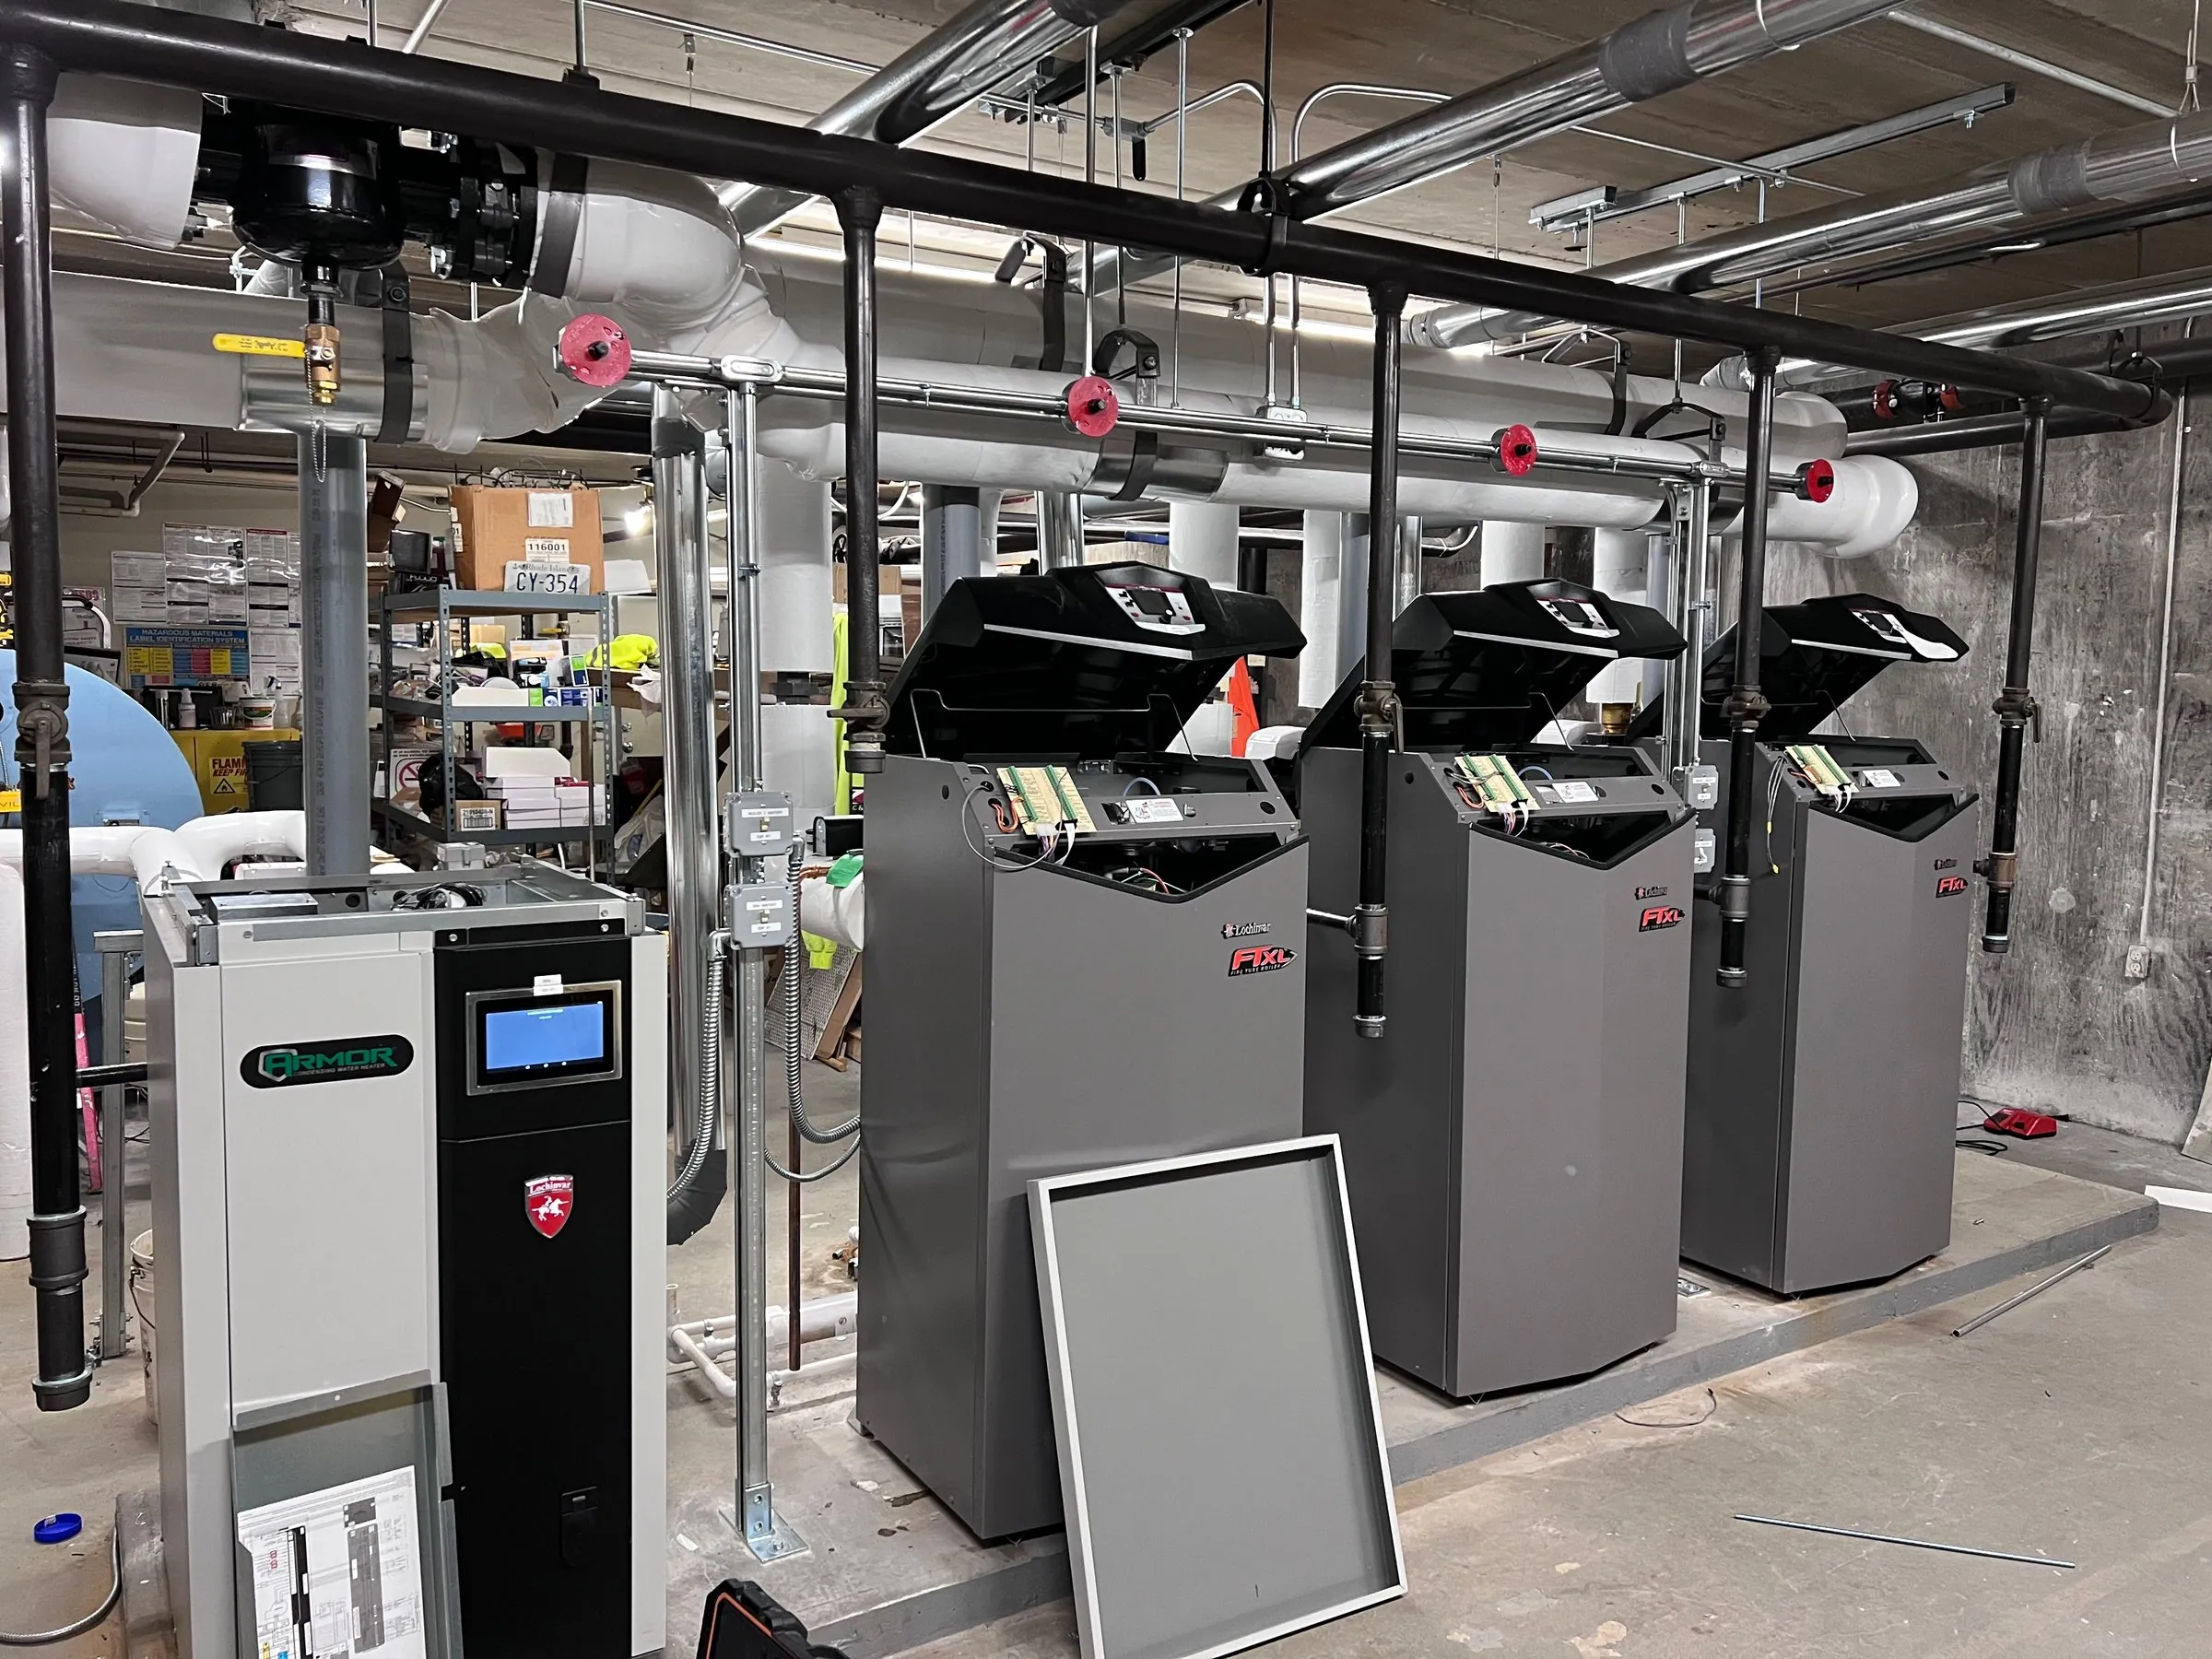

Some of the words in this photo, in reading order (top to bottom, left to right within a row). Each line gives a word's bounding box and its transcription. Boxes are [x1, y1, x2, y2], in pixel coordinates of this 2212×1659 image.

[528, 543, 566, 551] 116001
[517, 572, 578, 594] CY-354
[213, 769, 234, 777] KEEP
[1641, 905, 1682, 927] FTXL
[1231, 945, 1291, 971] FTXL
[265, 1046, 398, 1077] ARMOR
[529, 1181, 571, 1194] Lochinvar
